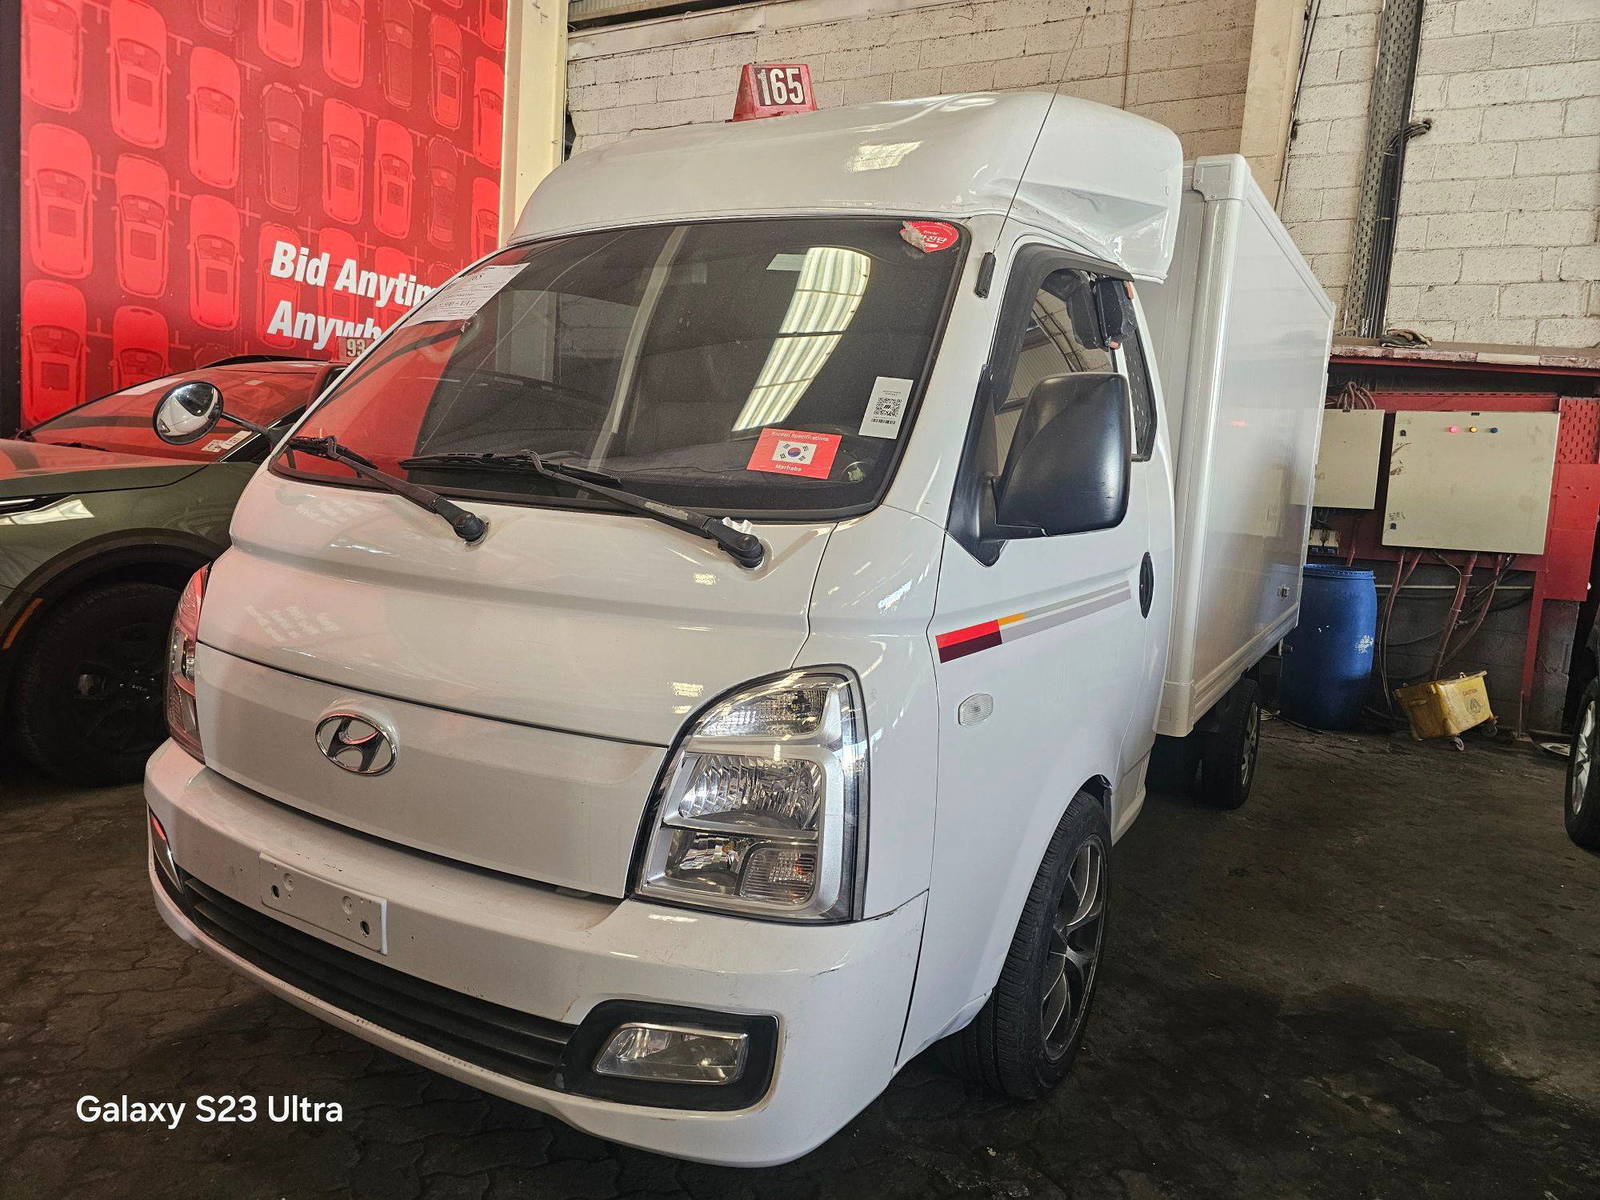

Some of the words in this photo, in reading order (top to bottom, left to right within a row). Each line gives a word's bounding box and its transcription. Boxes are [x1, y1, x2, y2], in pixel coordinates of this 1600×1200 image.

[757, 68, 804, 106] 165
[270, 240, 330, 287] Bid
[791, 433, 829, 442] Specifications
[775, 463, 802, 472] Marhaba
